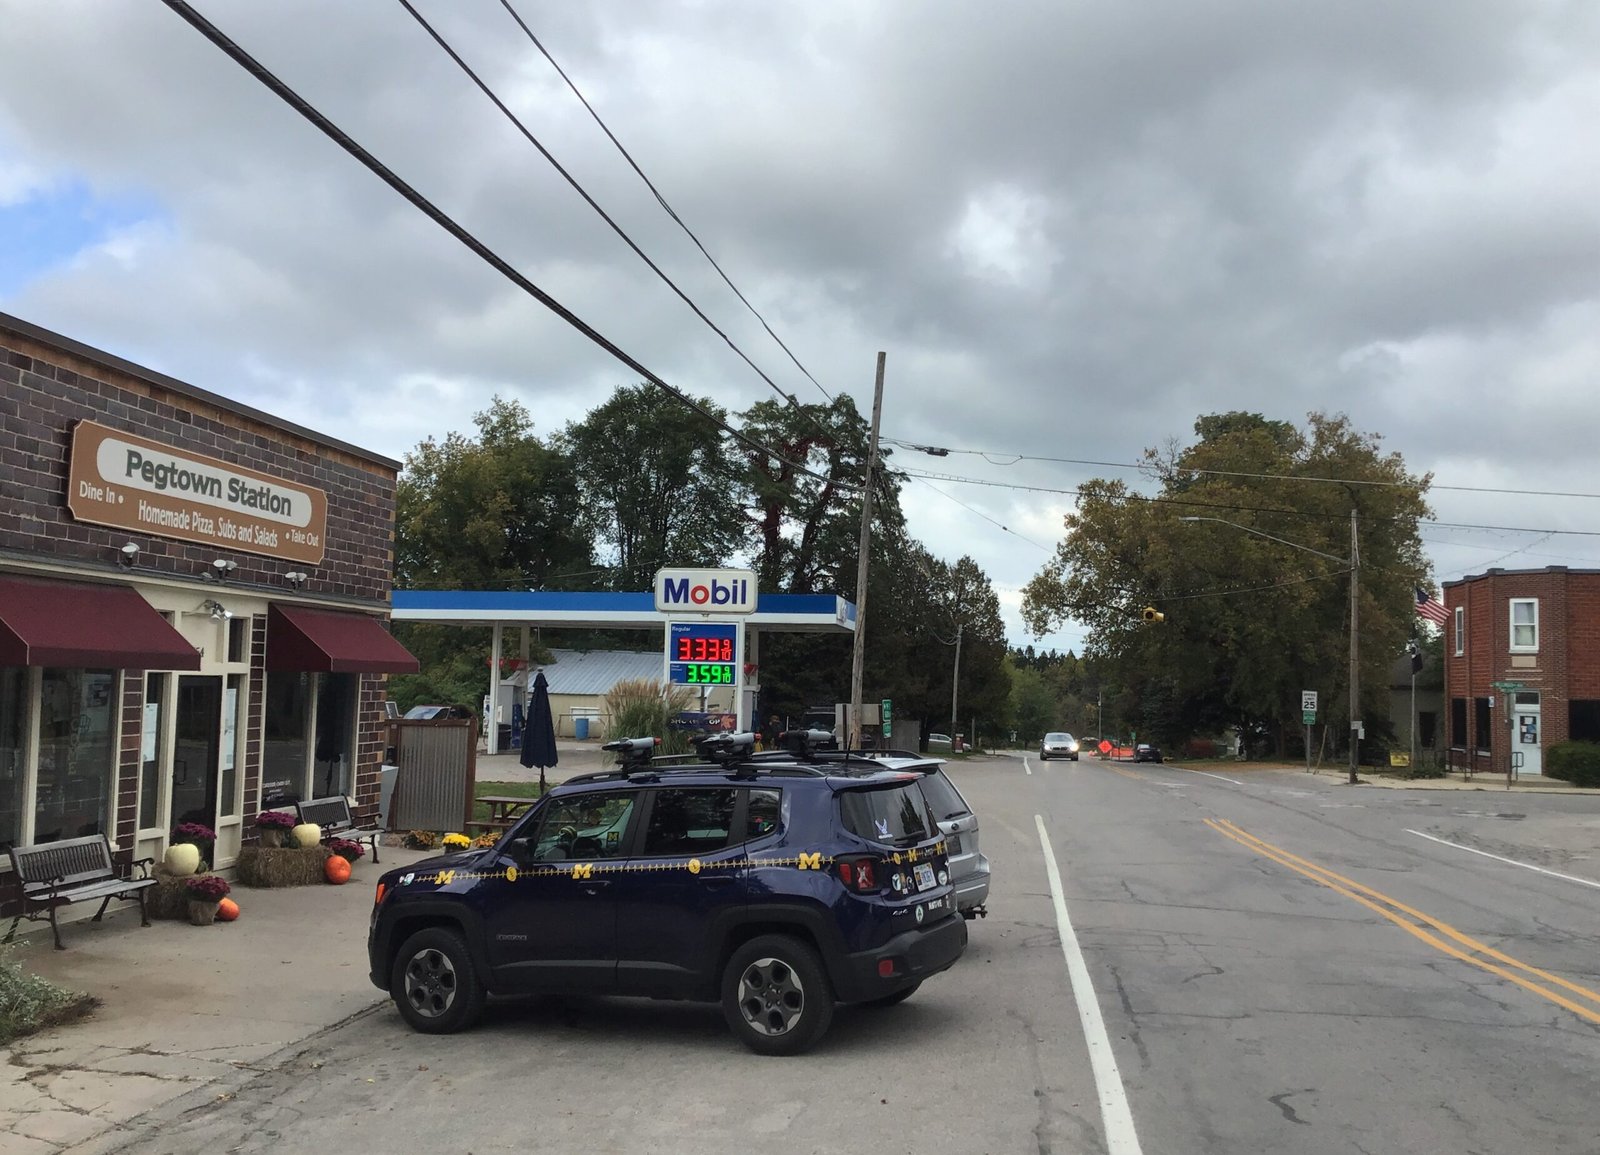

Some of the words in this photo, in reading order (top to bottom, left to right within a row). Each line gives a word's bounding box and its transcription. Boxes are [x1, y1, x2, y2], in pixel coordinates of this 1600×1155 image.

[79, 480, 103, 502] Dine
[105, 486, 115, 504] In
[125, 449, 222, 500] Pegtown
[227, 478, 292, 517] Station
[138, 499, 190, 530] Homemade
[192, 511, 216, 537] Pizza,
[217, 517, 236, 538] Subs
[238, 522, 253, 542] and
[254, 526, 278, 548] Salads
[291, 528, 305, 544] Take
[307, 532, 319, 547] Out
[664, 578, 746, 605] Mobil
[679, 638, 720, 661] 3.33
[687, 665, 721, 683] 3.59
[572, 863, 593, 879] M
[798, 852, 821, 869] M
[434, 869, 455, 885] M
